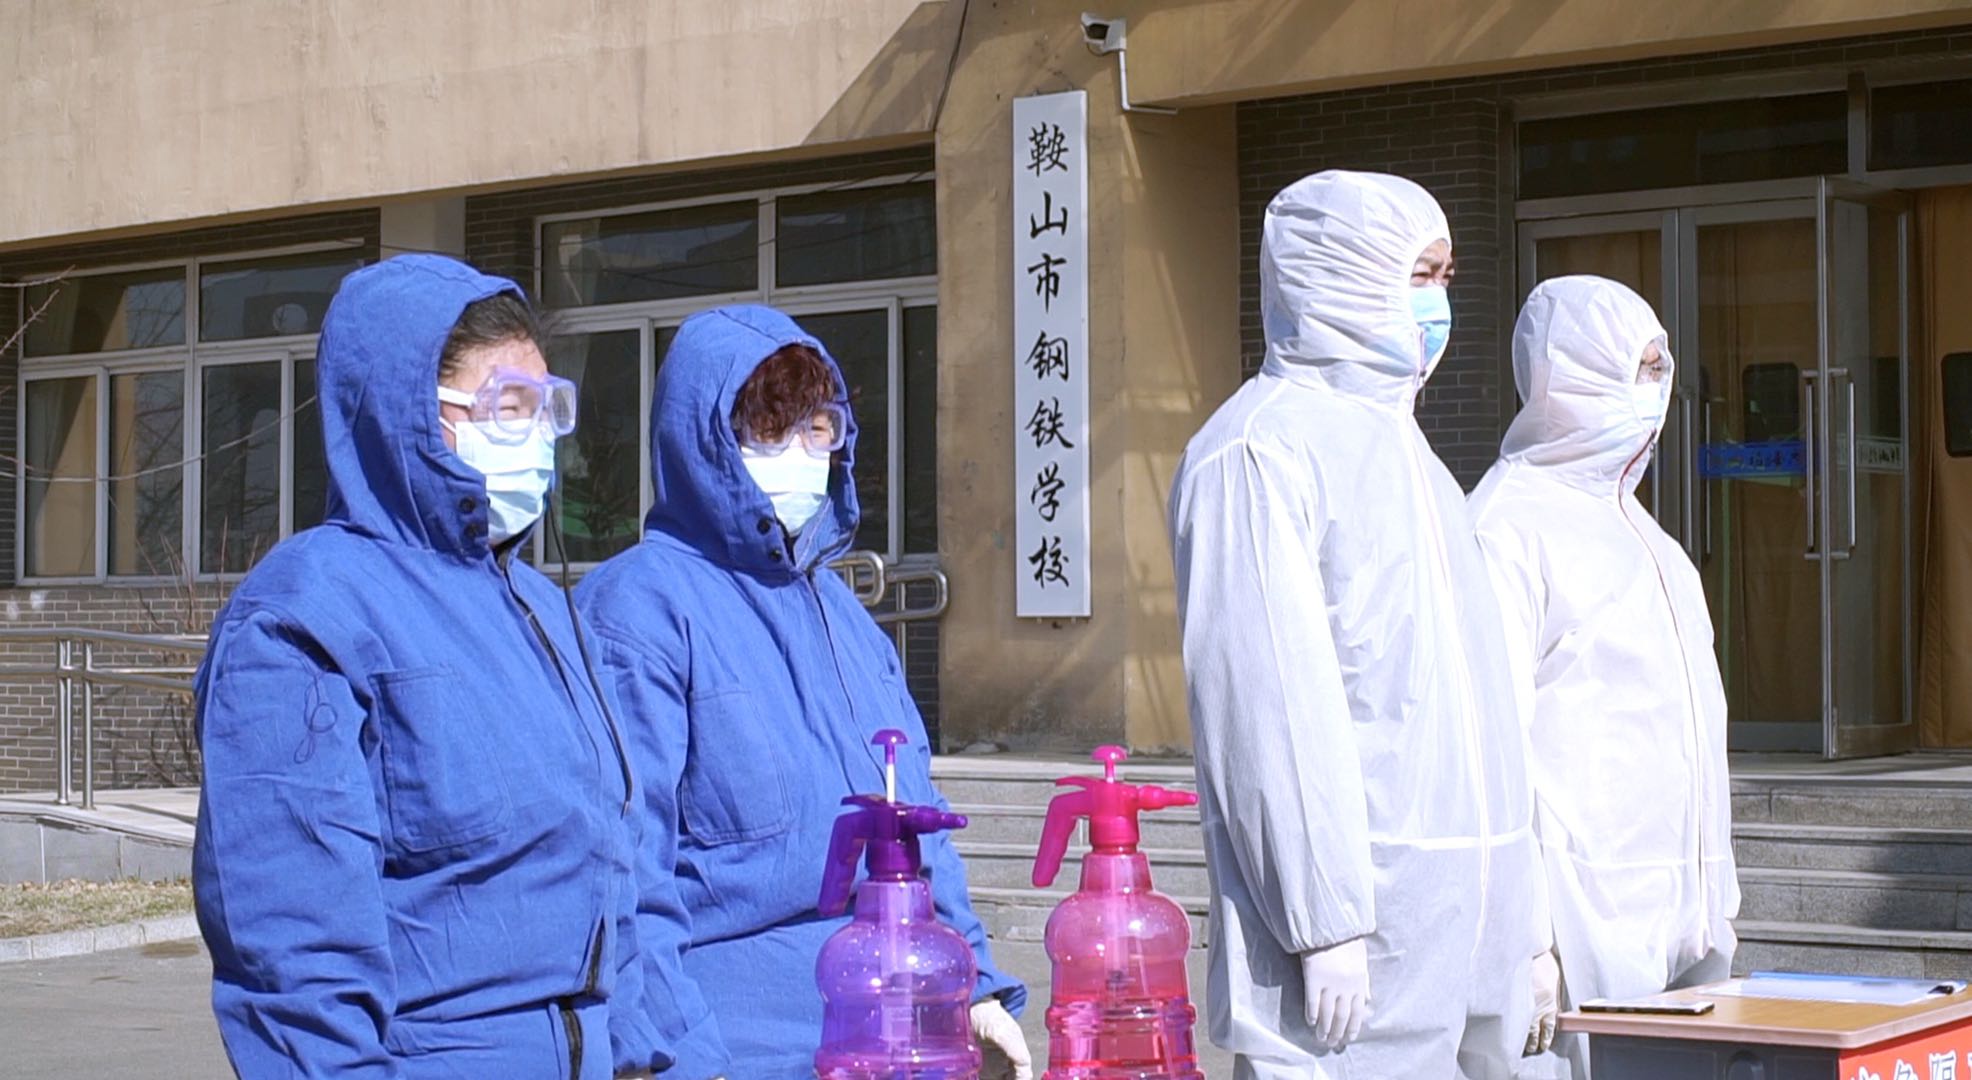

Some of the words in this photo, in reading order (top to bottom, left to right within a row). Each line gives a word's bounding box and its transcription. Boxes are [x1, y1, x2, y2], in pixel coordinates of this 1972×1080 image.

[1024, 121, 1075, 589] 鞍山市钢铁学校
